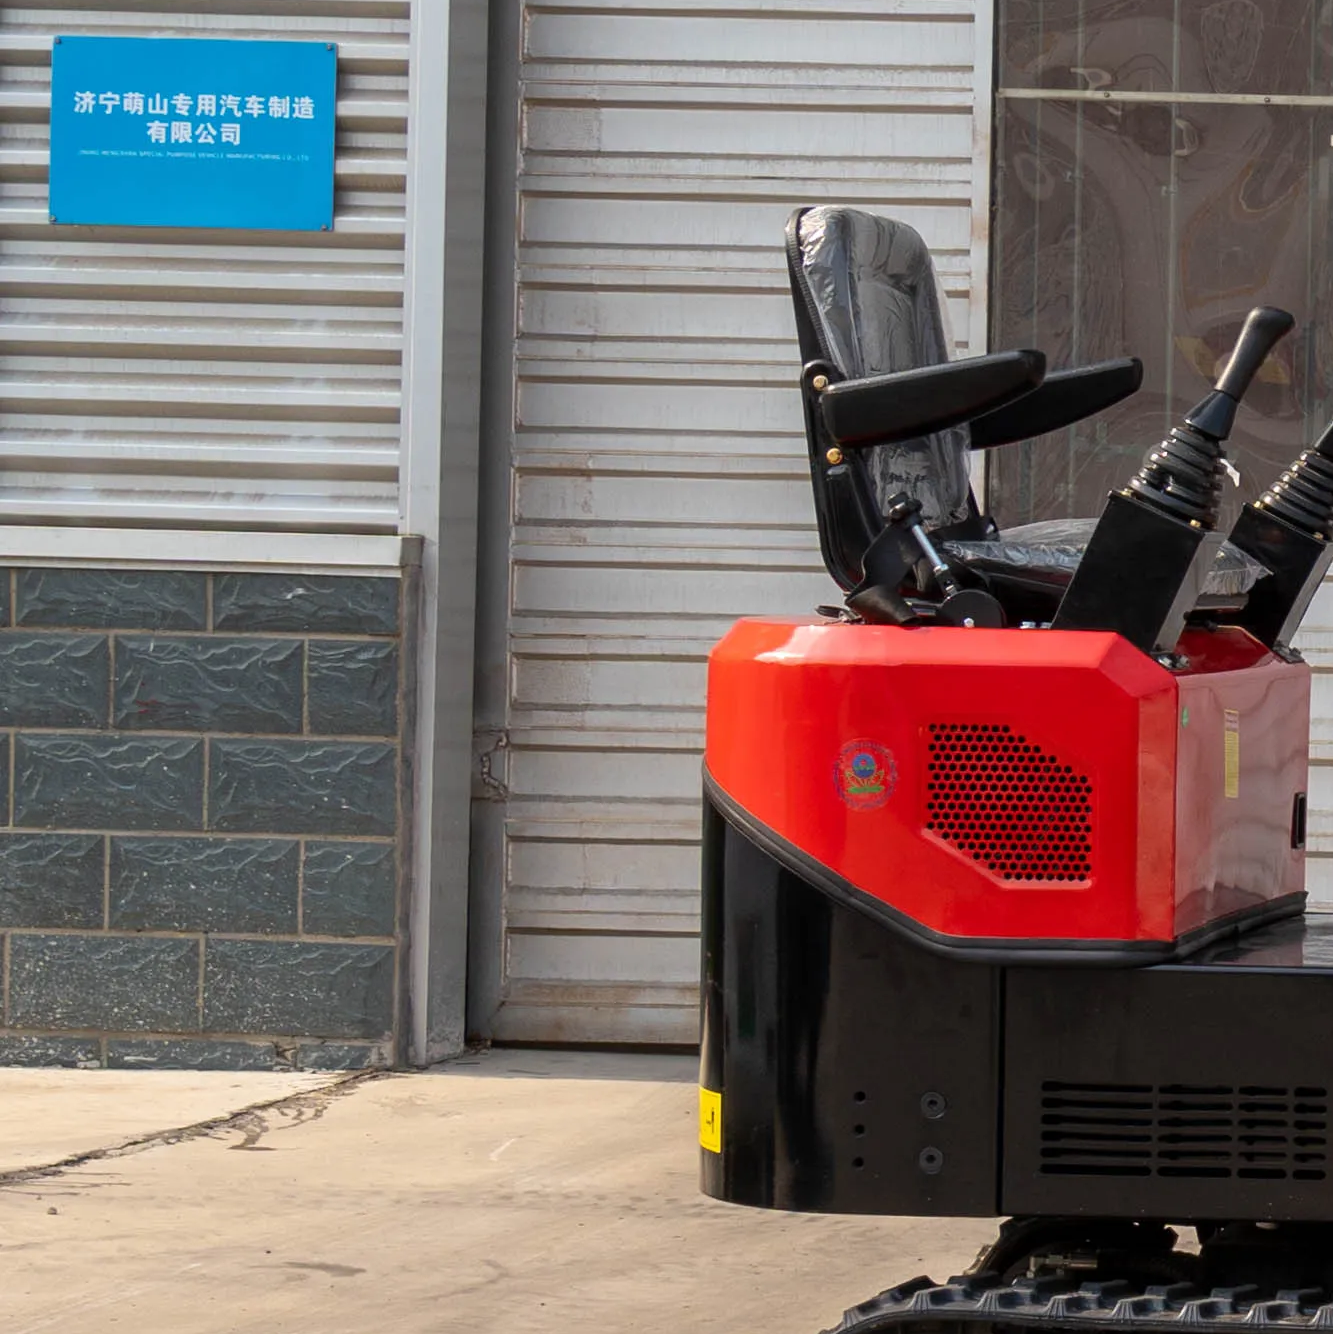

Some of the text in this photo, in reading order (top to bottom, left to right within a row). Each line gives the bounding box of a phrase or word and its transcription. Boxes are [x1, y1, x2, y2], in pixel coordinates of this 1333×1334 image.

[73, 91, 315, 120] 济宁萌山专用汽车制造
[147, 120, 242, 146] 有限公司
